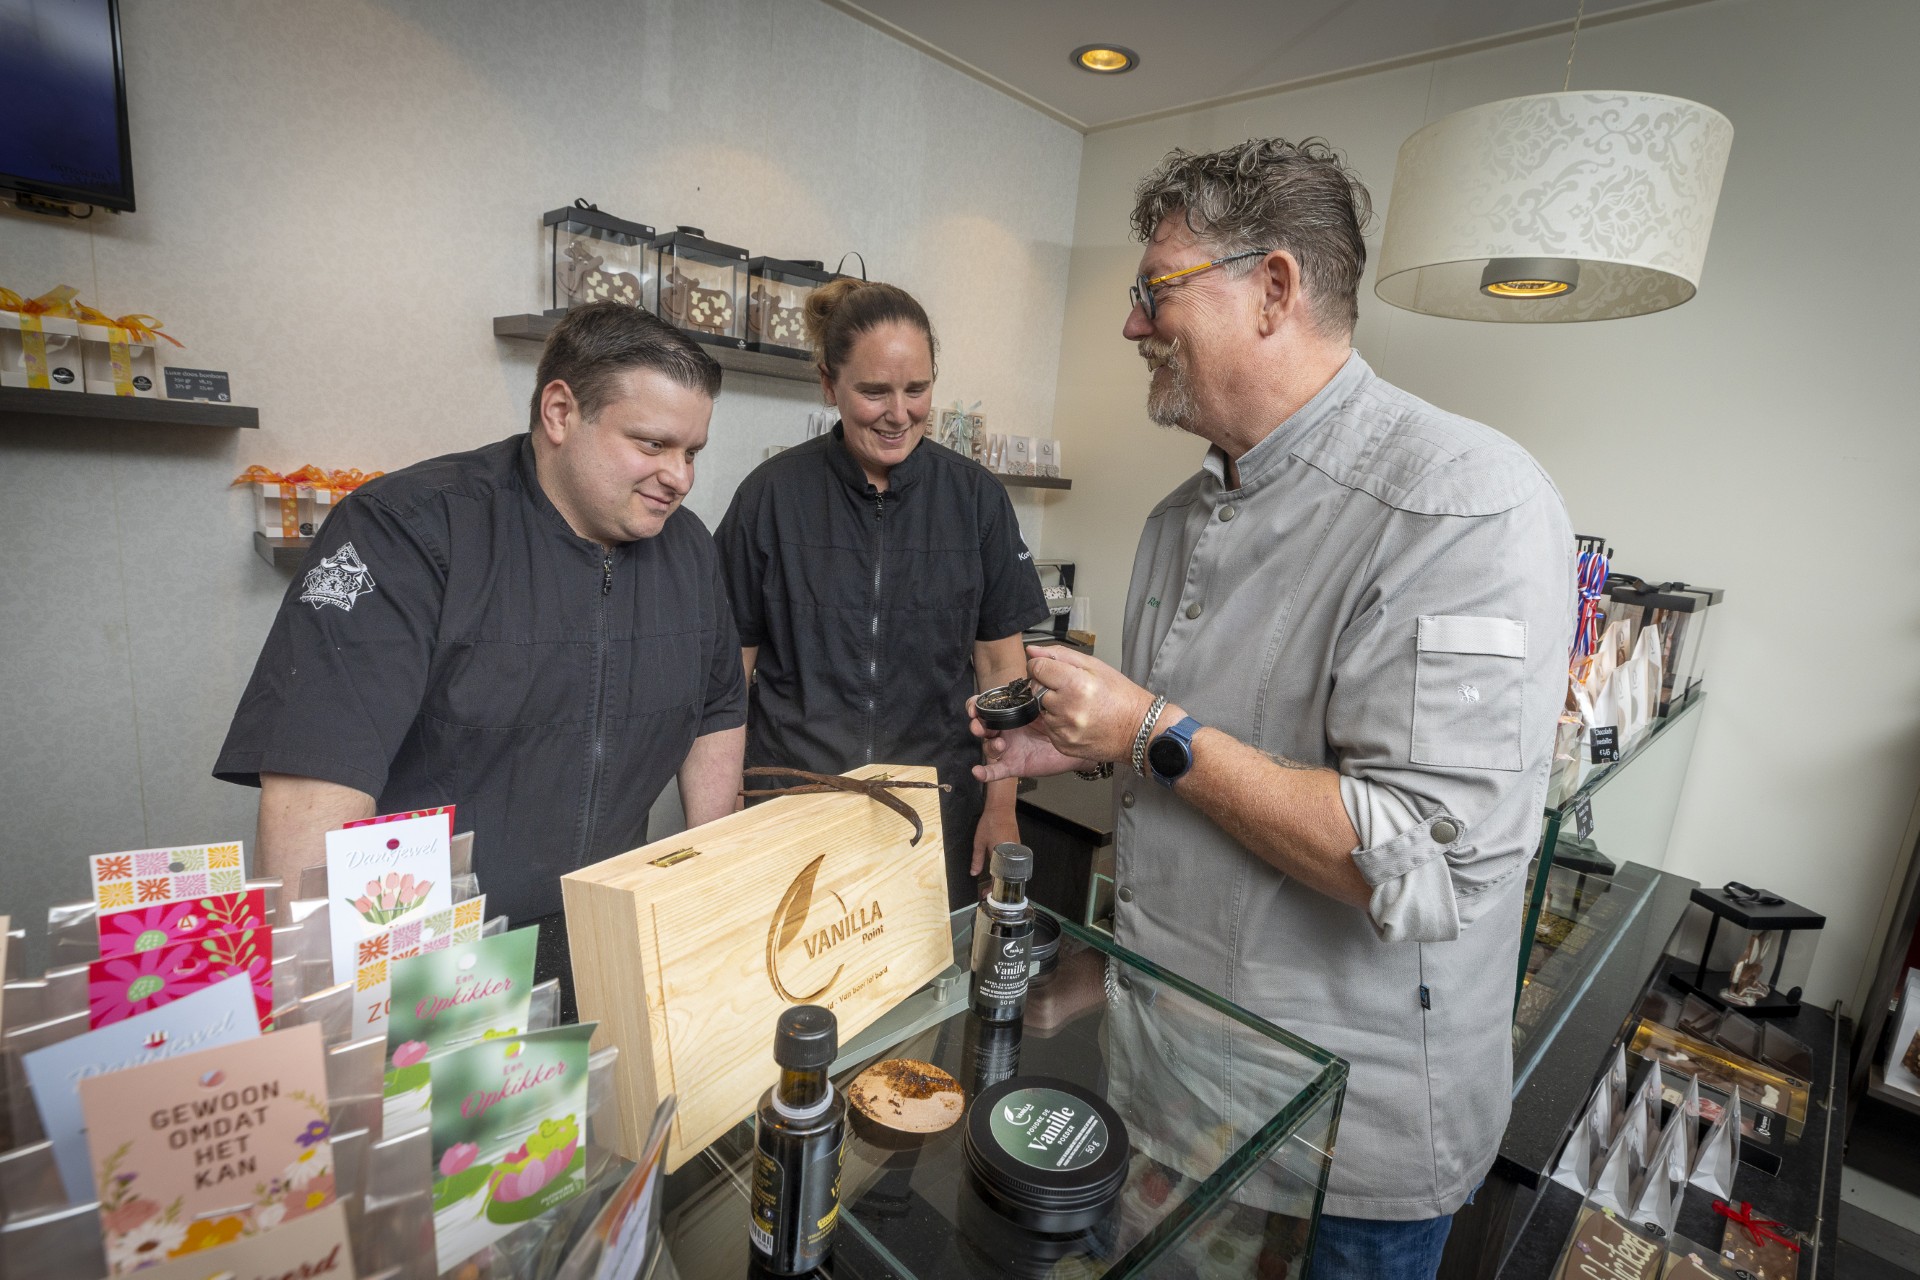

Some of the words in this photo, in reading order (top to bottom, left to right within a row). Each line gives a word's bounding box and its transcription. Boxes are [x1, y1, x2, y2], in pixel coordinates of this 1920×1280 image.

[803, 900, 883, 960] VANILLA
[862, 924, 884, 945] Point
[455, 974, 474, 985] Een
[994, 963, 1027, 975] Vanille
[415, 977, 516, 1021] Opkikker
[838, 991, 852, 1003] Van
[1008, 998, 1016, 1006] ml
[503, 1062, 524, 1076] Een
[460, 1061, 567, 1120] Opkikker
[150, 1080, 280, 1131] GEWOON
[168, 1105, 270, 1151] OMDAT
[1026, 1115, 1045, 1136] POUDRE
[1041, 1108, 1051, 1118] DE
[1027, 1107, 1075, 1151] Vanille
[1057, 1125, 1076, 1146] POEDER
[195, 1134, 250, 1168] HET
[1085, 1144, 1095, 1154] 50
[1093, 1140, 1101, 1148] g
[194, 1155, 257, 1191] KAN
